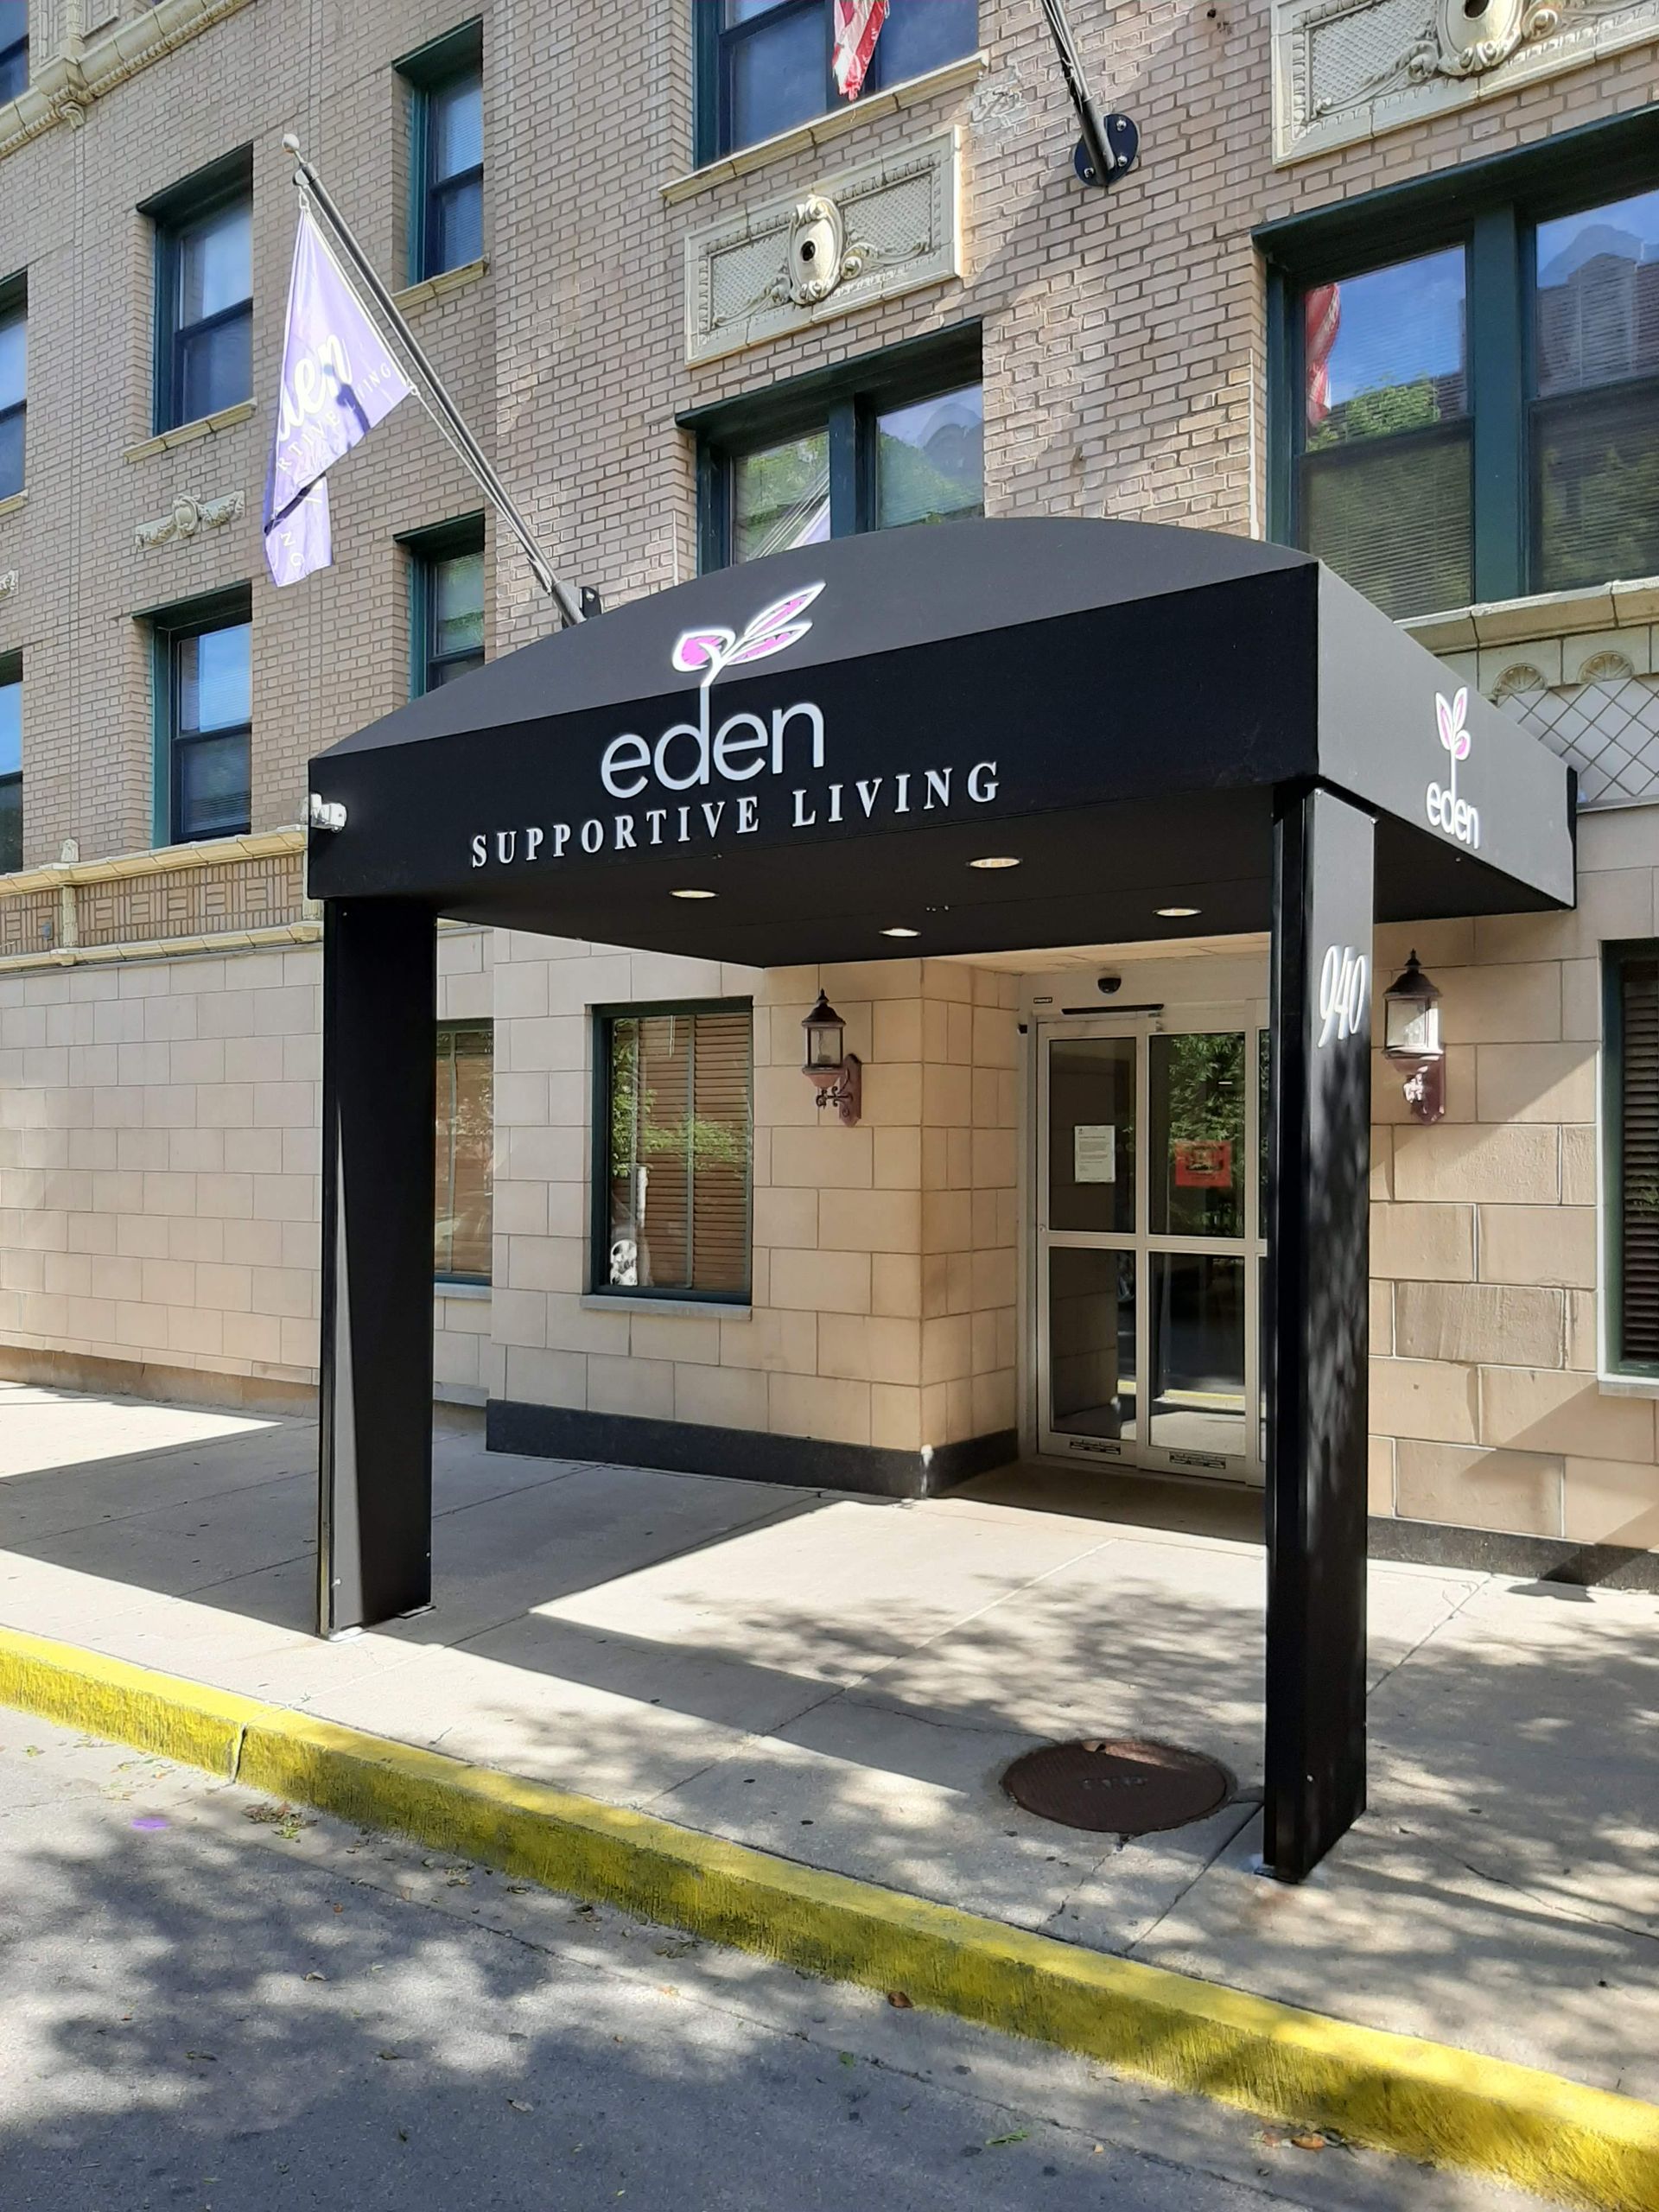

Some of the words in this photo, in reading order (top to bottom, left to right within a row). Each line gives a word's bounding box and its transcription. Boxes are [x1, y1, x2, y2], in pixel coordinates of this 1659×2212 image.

[600, 683, 825, 798] eden
[471, 796, 760, 868] SUPPORTIVE
[791, 760, 1000, 828] LIVING
[1426, 759, 1481, 850] eden
[1317, 944, 1368, 1048] 940
